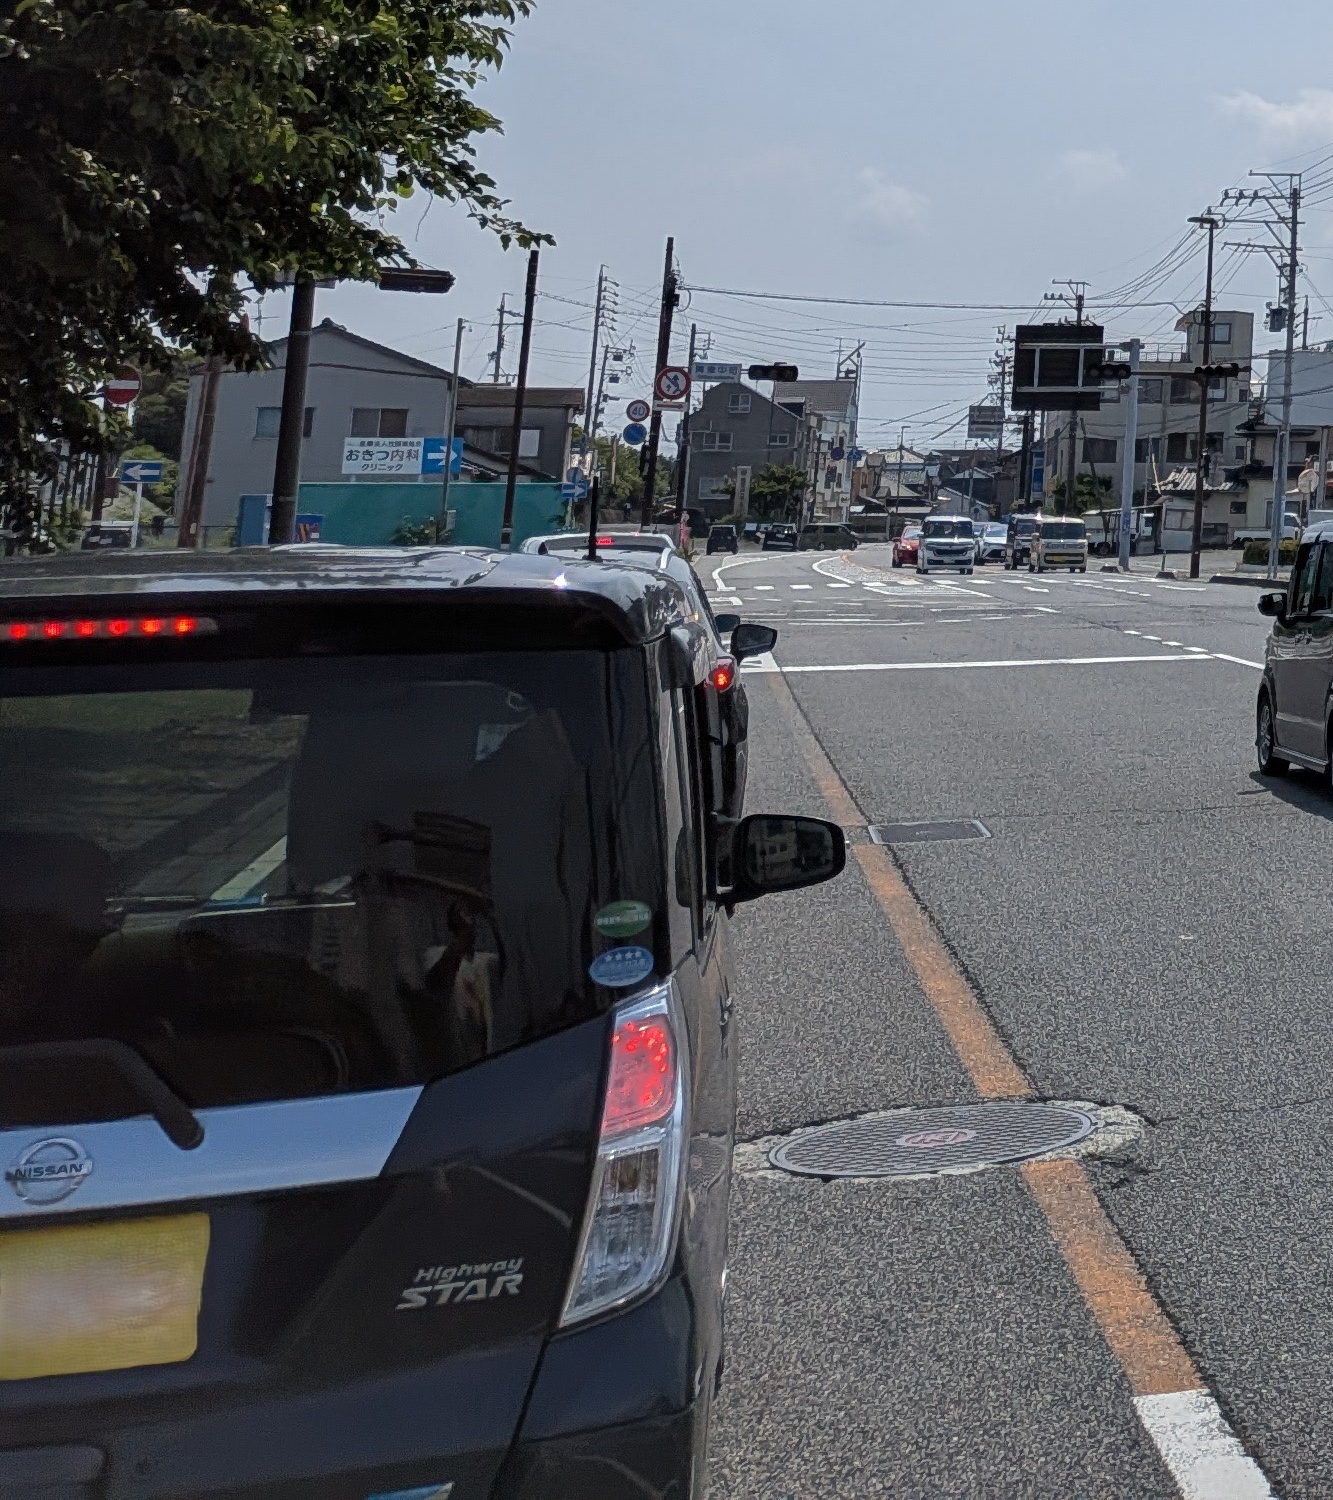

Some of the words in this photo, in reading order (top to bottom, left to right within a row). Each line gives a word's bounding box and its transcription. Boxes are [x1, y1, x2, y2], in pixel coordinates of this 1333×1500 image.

[632, 406, 645, 416] 40
[345, 448, 420, 461] おきつ内科
[361, 463, 404, 471] クリニック
[14, 1163, 84, 1178] NISSAN
[413, 1258, 524, 1284] Highway
[396, 1273, 523, 1309] STAR
